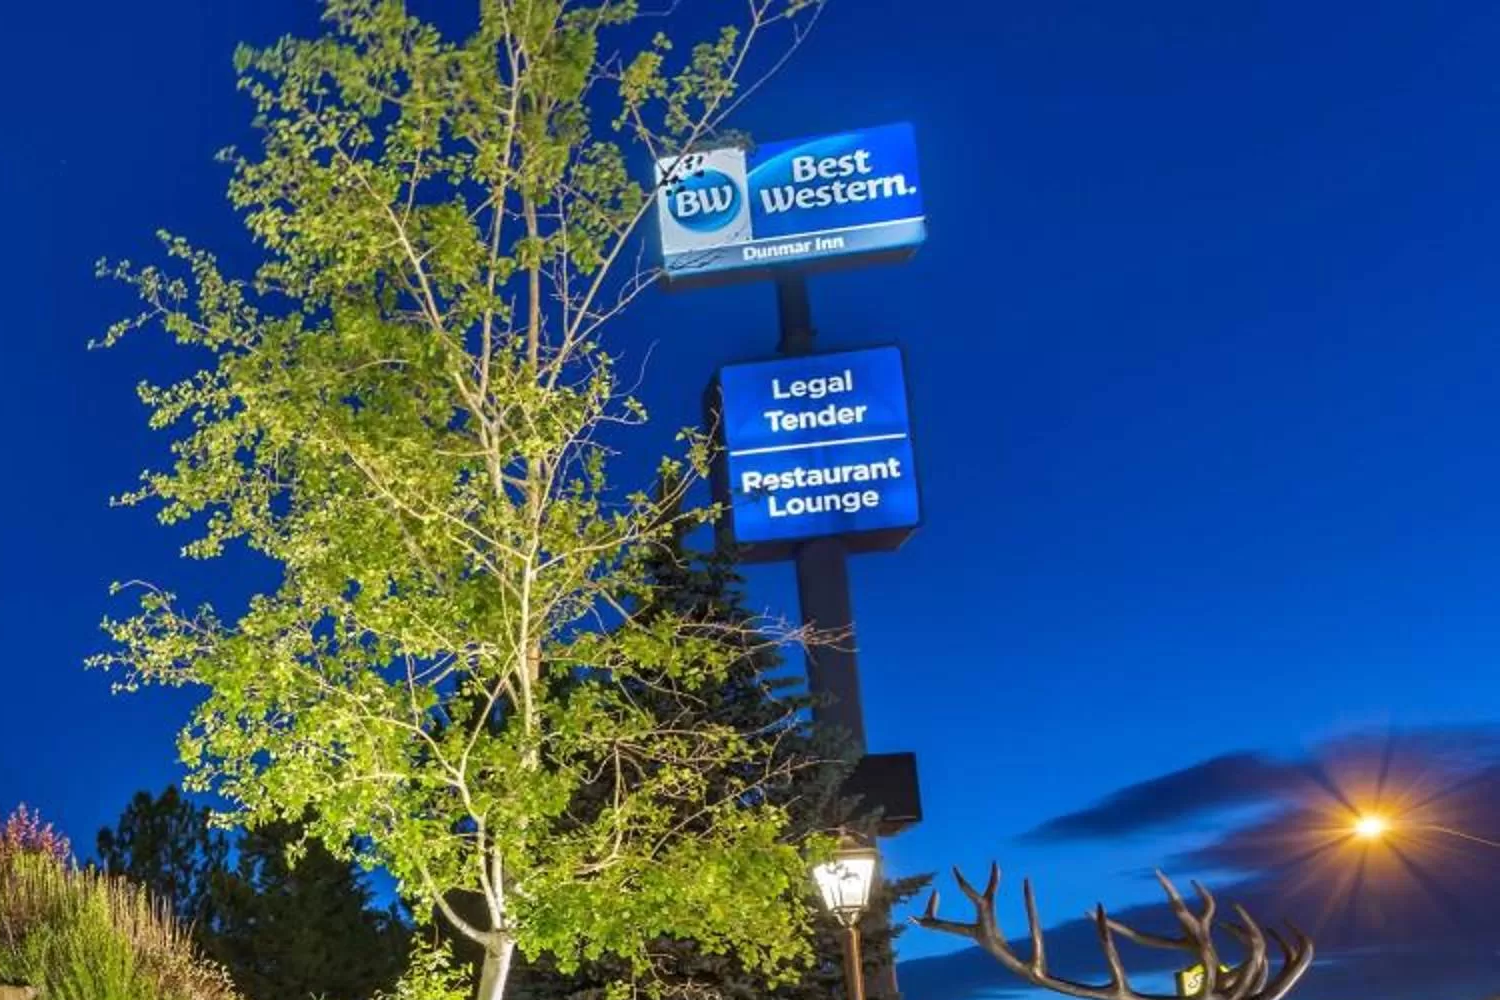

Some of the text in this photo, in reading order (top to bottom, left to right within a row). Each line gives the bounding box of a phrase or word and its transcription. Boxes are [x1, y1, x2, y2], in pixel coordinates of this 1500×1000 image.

[792, 149, 870, 182] Best
[676, 184, 733, 217] BW
[743, 236, 845, 260] Dunmar Inn
[772, 369, 853, 400] Legal
[764, 404, 867, 432] Tender
[742, 457, 901, 492] Restaurant
[768, 489, 879, 517] Lounge
